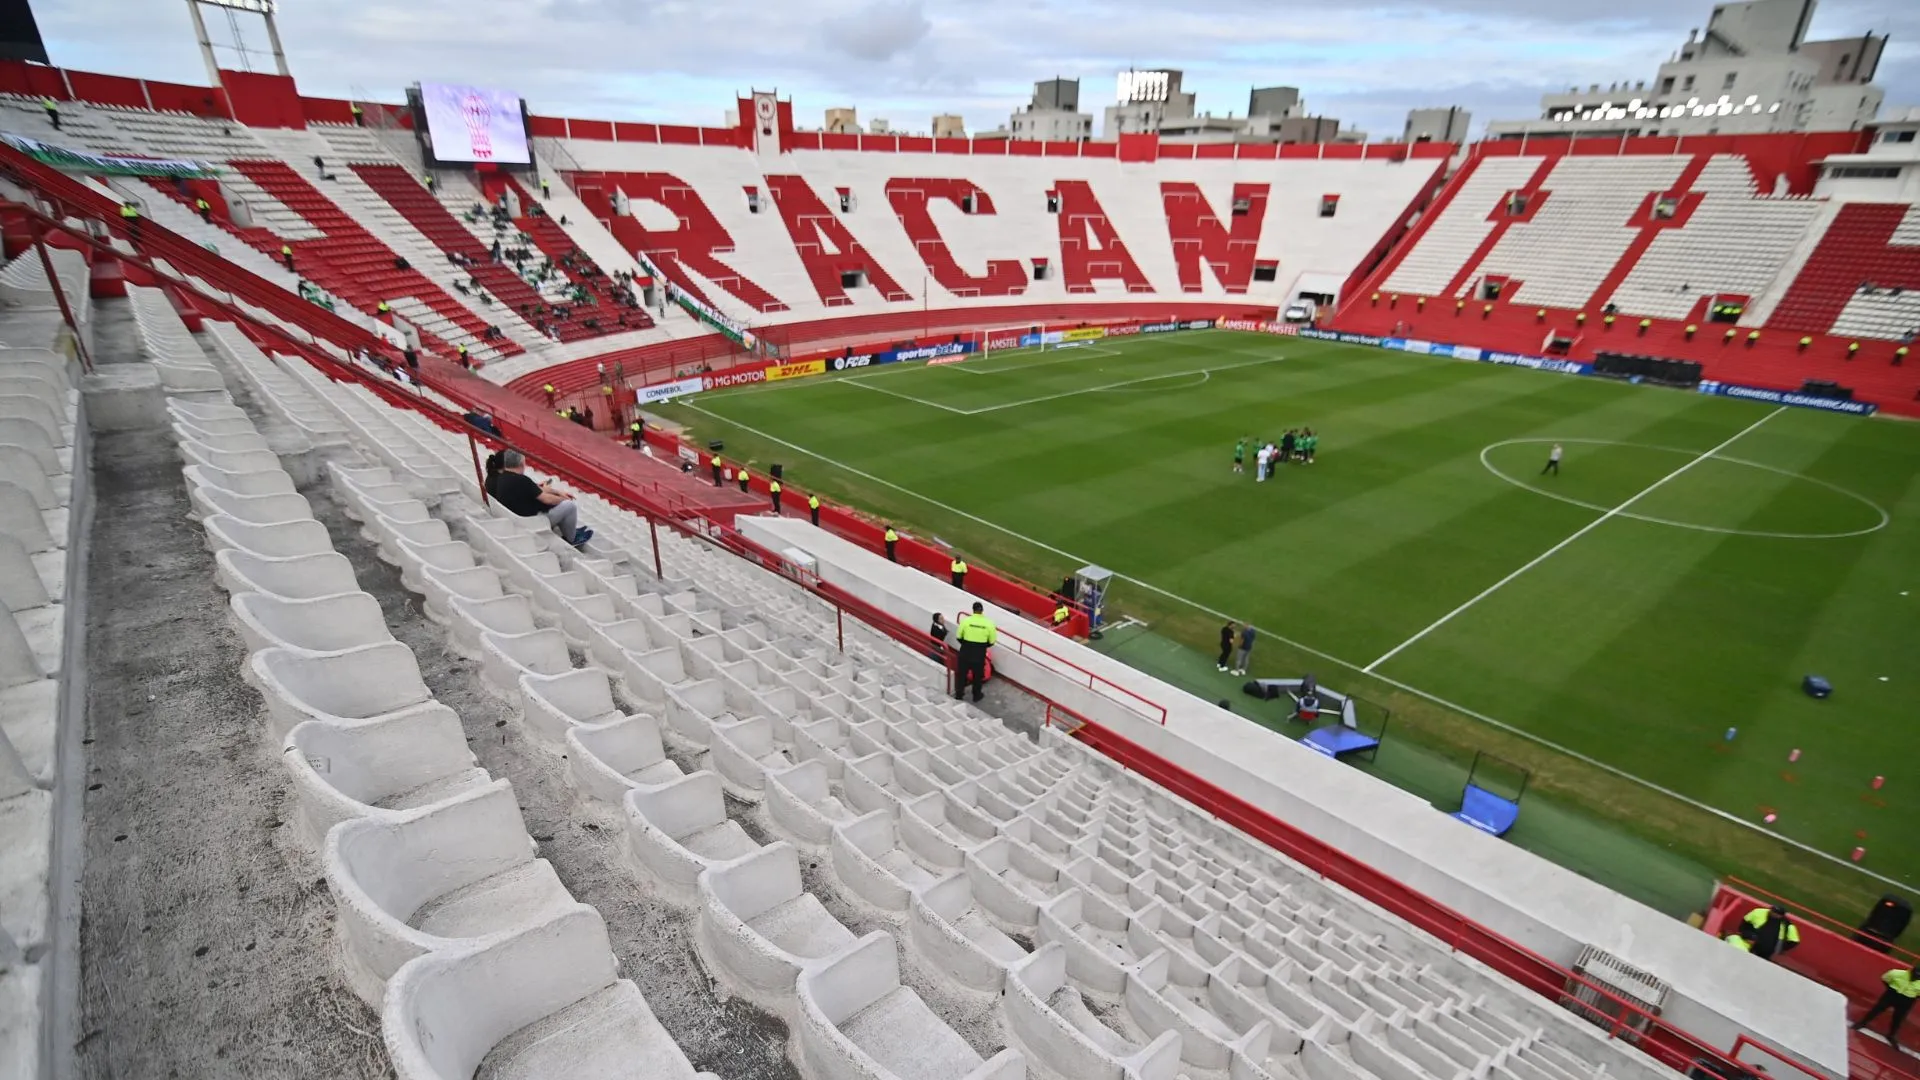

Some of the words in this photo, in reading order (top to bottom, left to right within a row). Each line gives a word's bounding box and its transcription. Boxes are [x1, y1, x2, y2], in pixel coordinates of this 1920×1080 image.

[1224, 320, 1256, 331] AMSTEL
[1267, 323, 1297, 336] AMSTEL
[989, 337, 1018, 349] AMSTEL
[780, 364, 813, 377] DHL
[715, 376, 731, 387] MG
[731, 370, 766, 384] MOTOR
[646, 386, 682, 398] CONMEBOL
[1727, 385, 1781, 402] CONMEBOL
[1782, 394, 1864, 413] SUDAMERICANA
